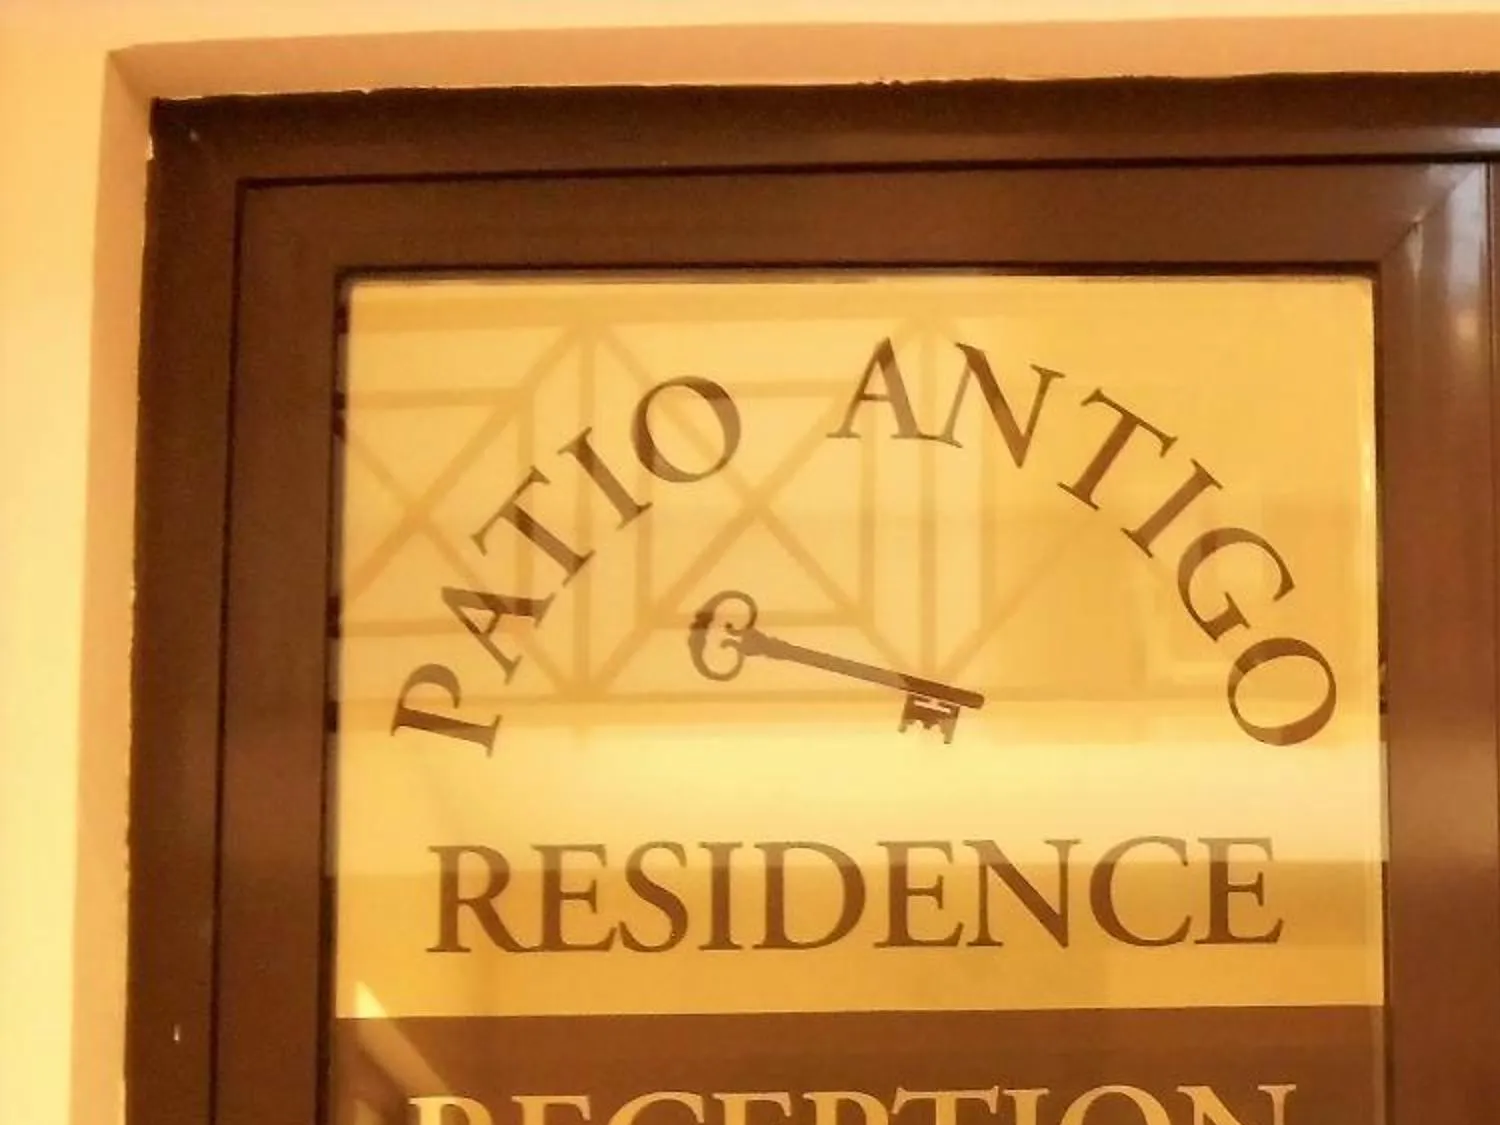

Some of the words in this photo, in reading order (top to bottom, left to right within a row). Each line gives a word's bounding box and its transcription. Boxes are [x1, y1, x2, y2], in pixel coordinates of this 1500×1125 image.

[390, 374, 742, 758] PATIO
[826, 336, 1337, 746] ANTIGO
[425, 834, 1284, 955] RESIDENCE
